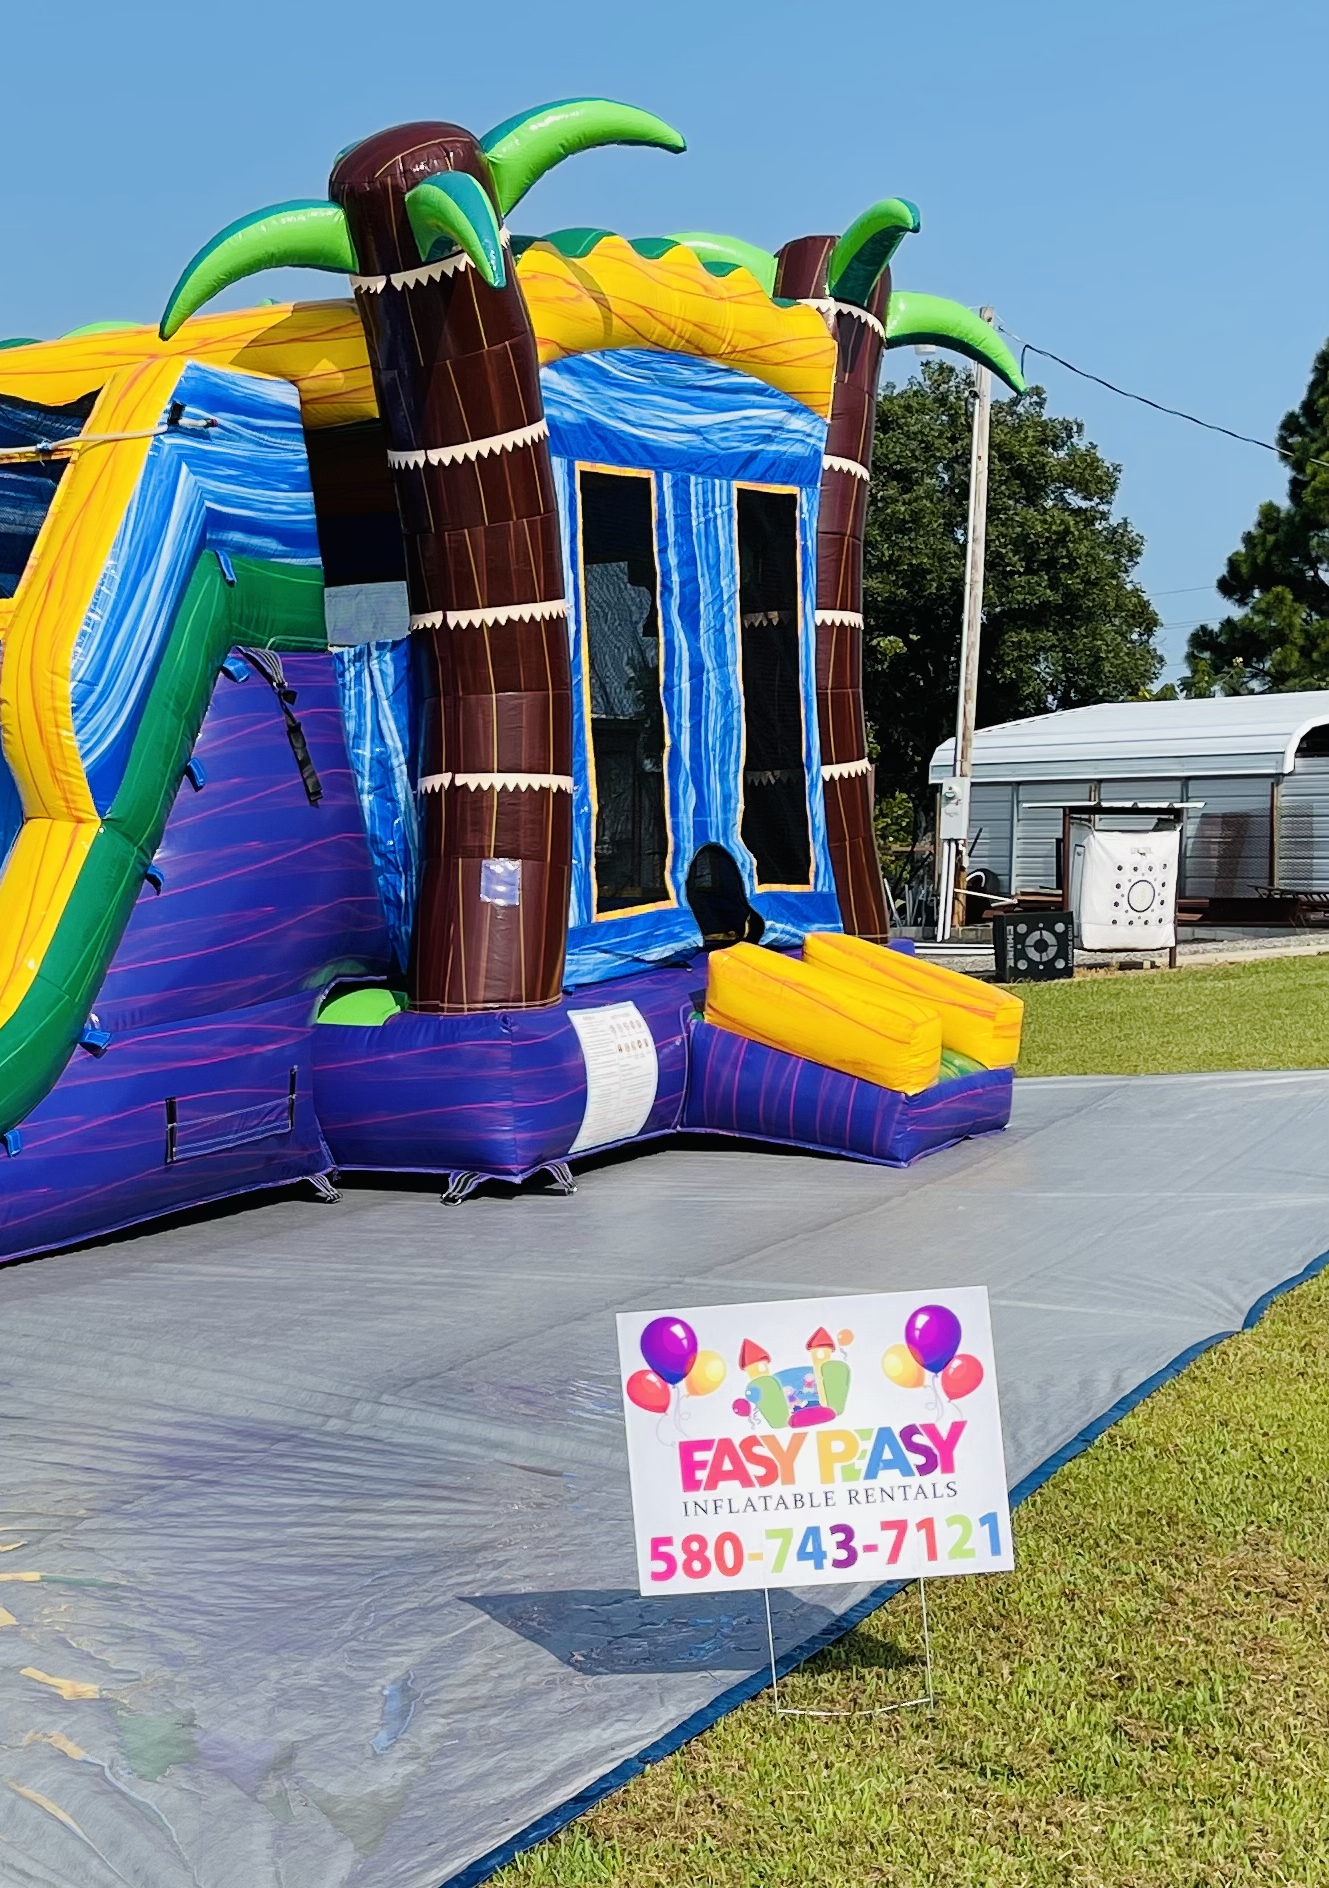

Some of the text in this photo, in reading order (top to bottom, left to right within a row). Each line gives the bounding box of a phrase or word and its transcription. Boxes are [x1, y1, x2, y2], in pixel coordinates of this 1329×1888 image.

[677, 1431, 808, 1493] EASY
[682, 1480, 959, 1518] INFLATABLE RENTALS
[649, 1511, 1002, 1583] 580-743-7121
